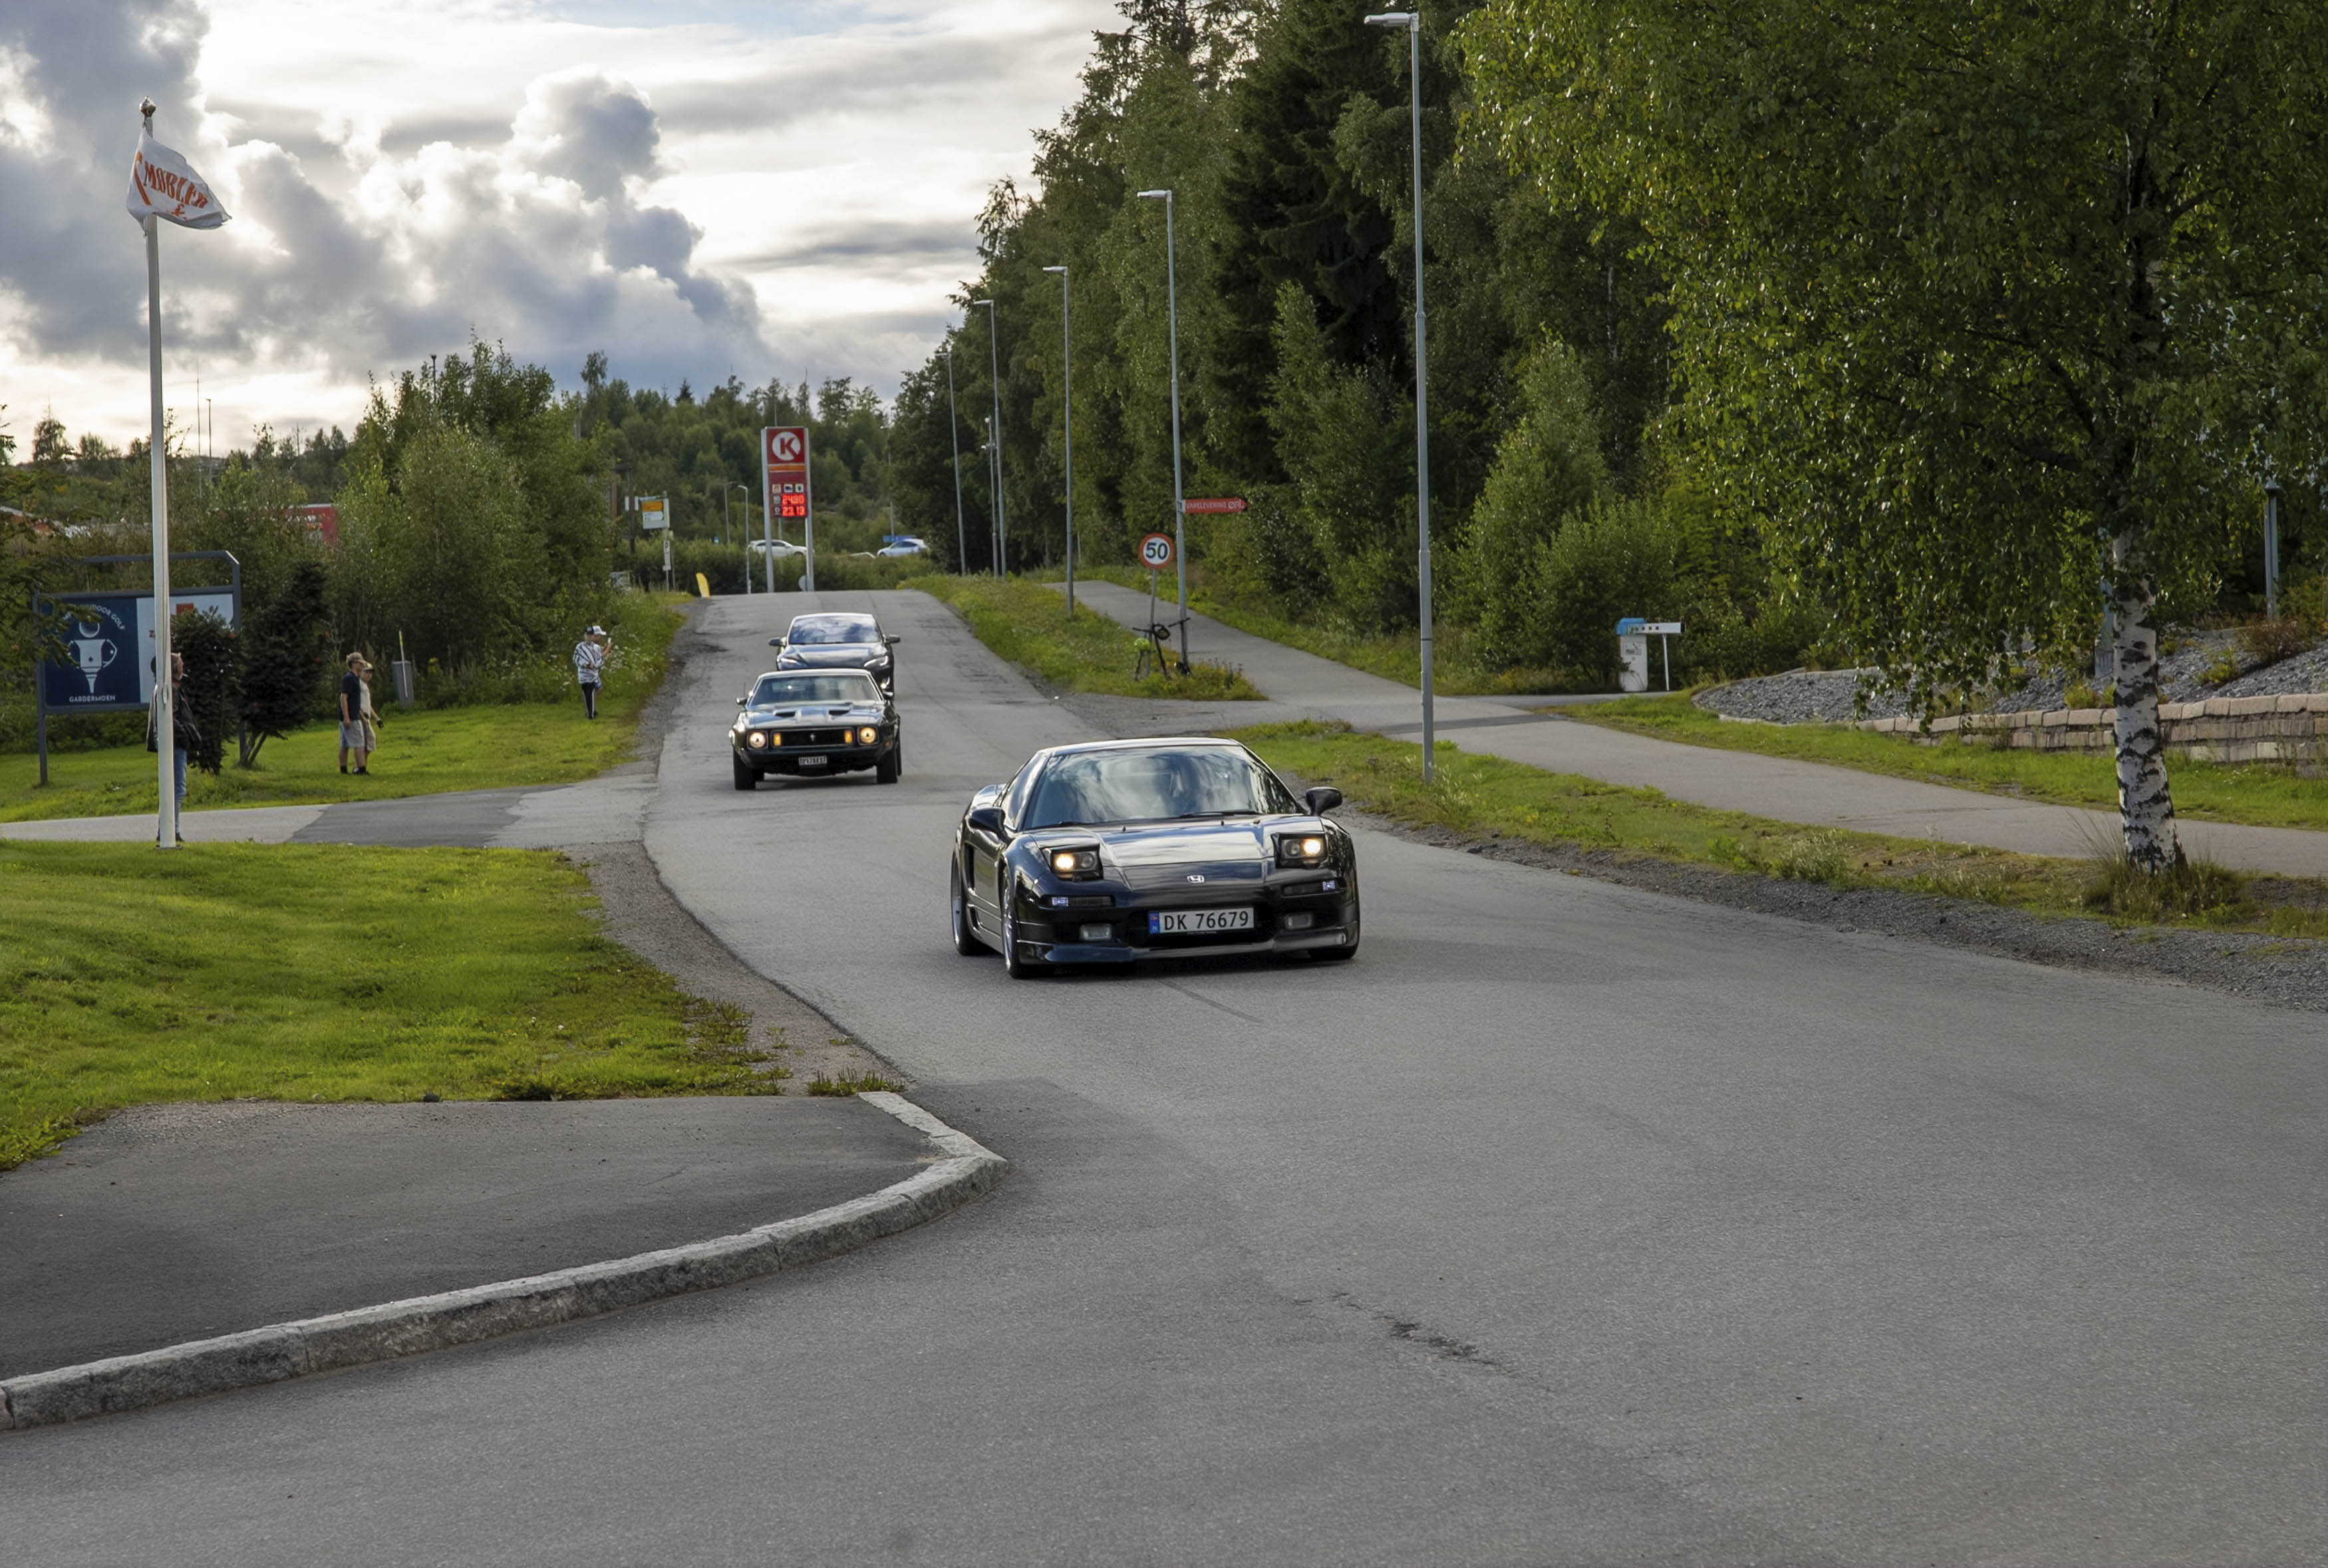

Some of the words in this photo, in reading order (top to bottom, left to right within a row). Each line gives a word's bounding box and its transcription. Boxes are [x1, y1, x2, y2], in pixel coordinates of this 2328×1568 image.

[780, 437, 798, 459] K
[1145, 542, 1168, 560] 50
[111, 613, 126, 630] GOLF
[69, 694, 116, 703] GARDERMOEN
[1165, 914, 1187, 930] DK
[1196, 910, 1248, 929] 76679
